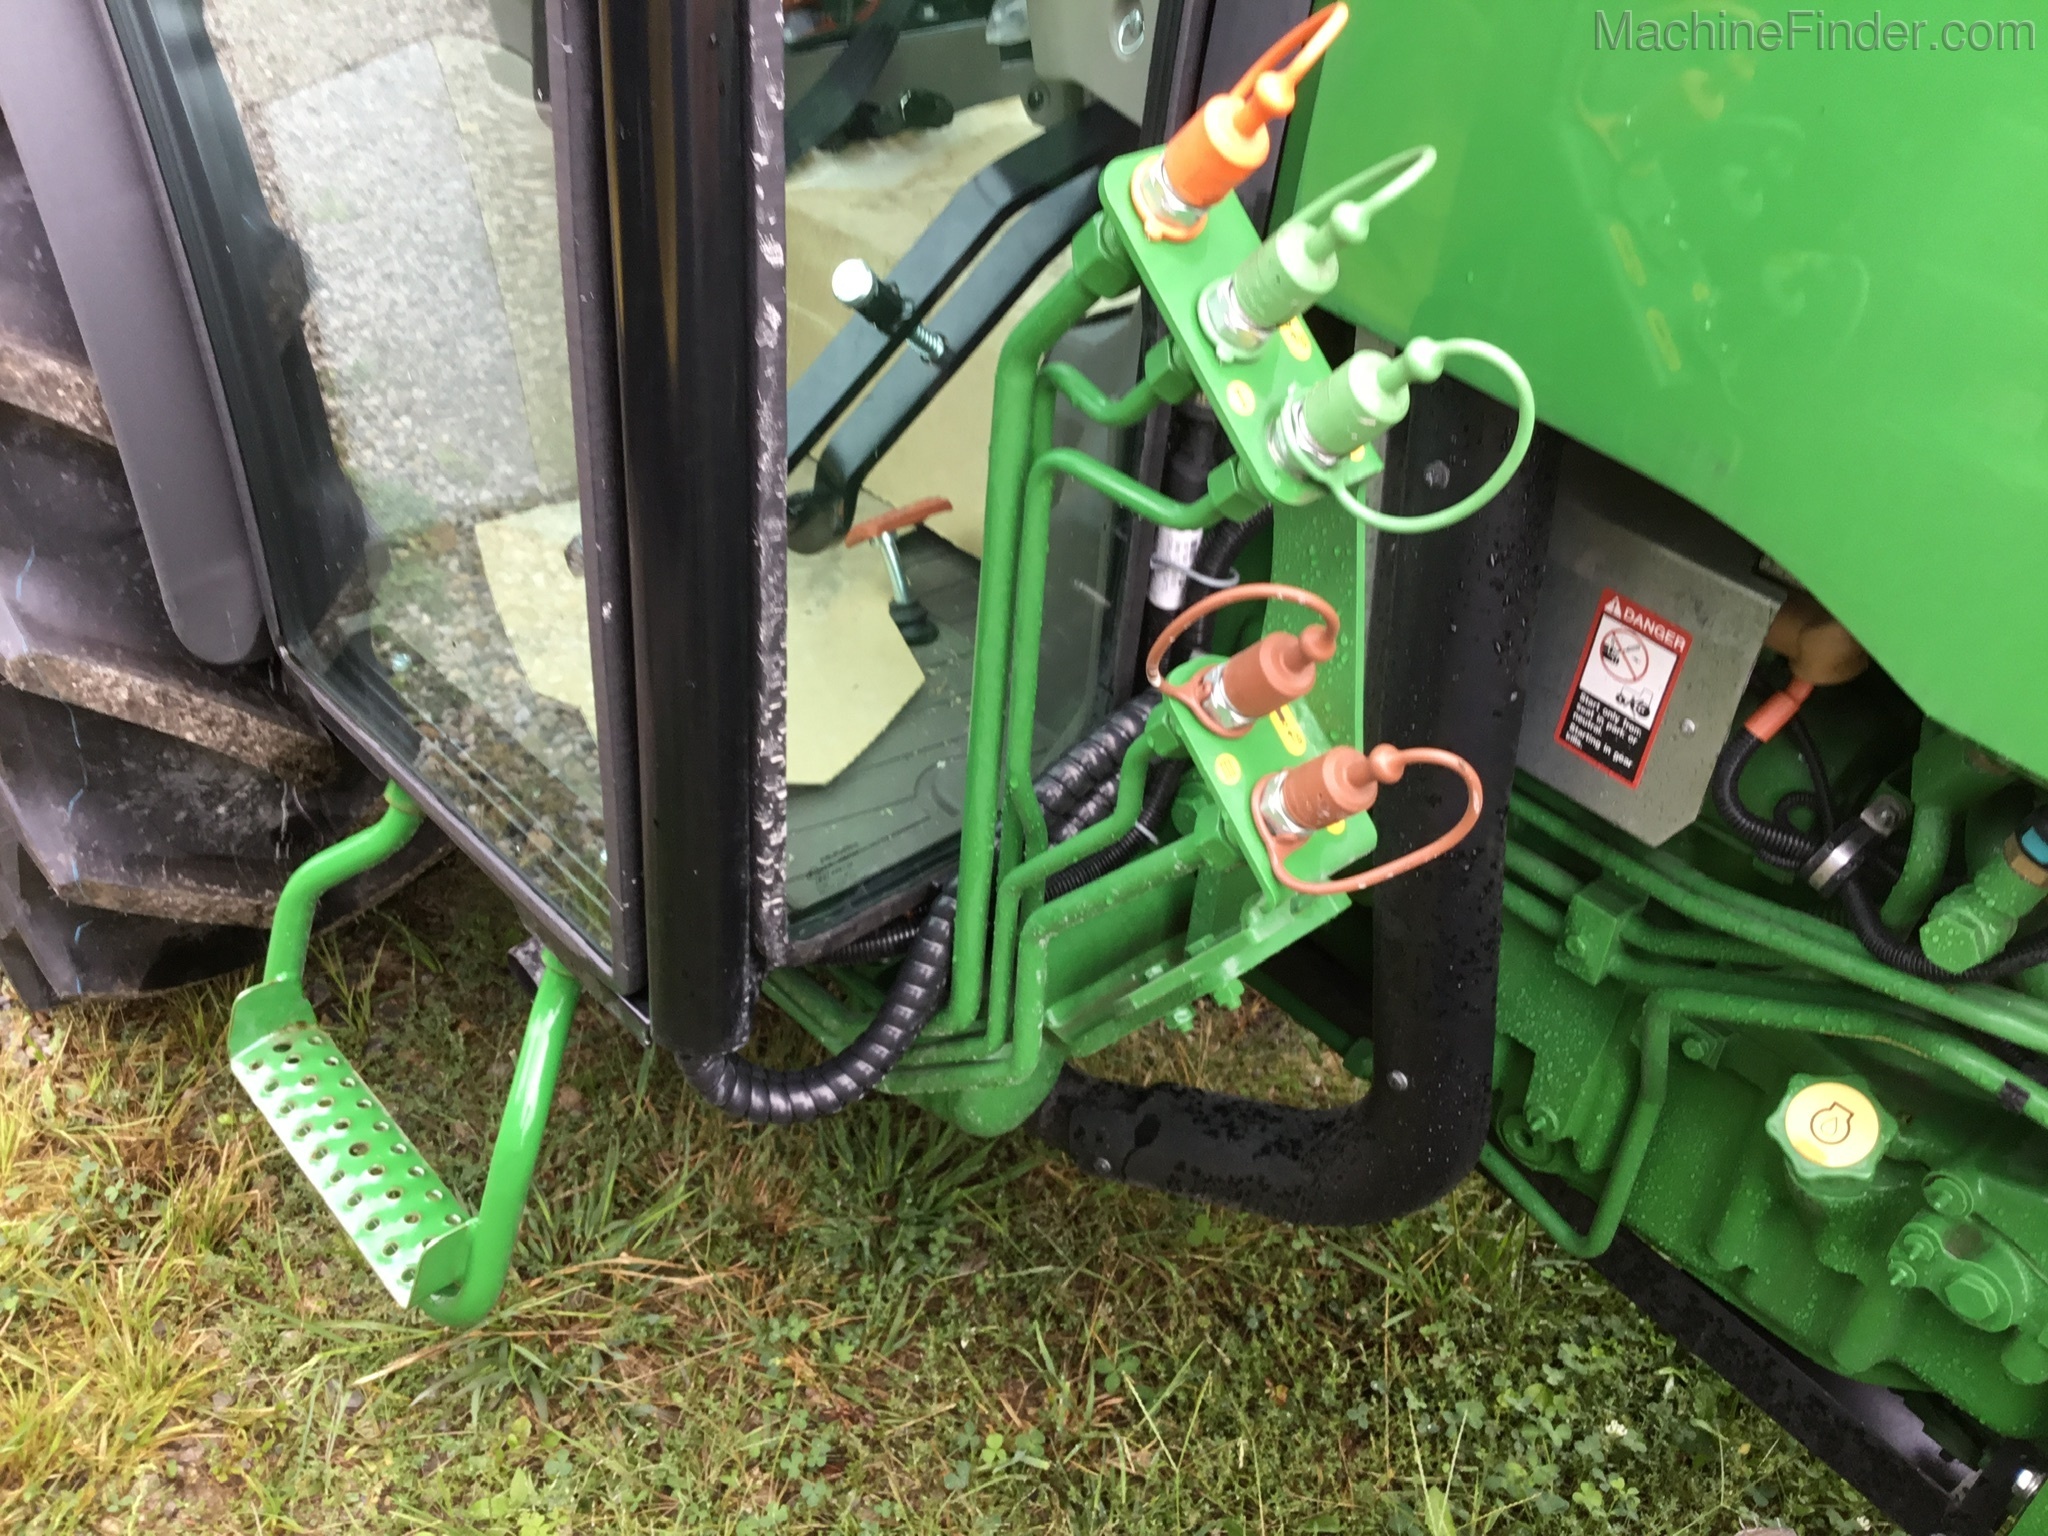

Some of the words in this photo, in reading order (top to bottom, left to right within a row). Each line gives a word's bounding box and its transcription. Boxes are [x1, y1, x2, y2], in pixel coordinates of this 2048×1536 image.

[1622, 606, 1686, 653] DANGER
[1580, 691, 1600, 713] Start
[1602, 706, 1620, 725] only
[1623, 717, 1642, 738] from
[1606, 721, 1625, 740] park
[1569, 721, 1601, 751] Starting
[1603, 742, 1611, 757] in
[1612, 750, 1633, 769] gear
